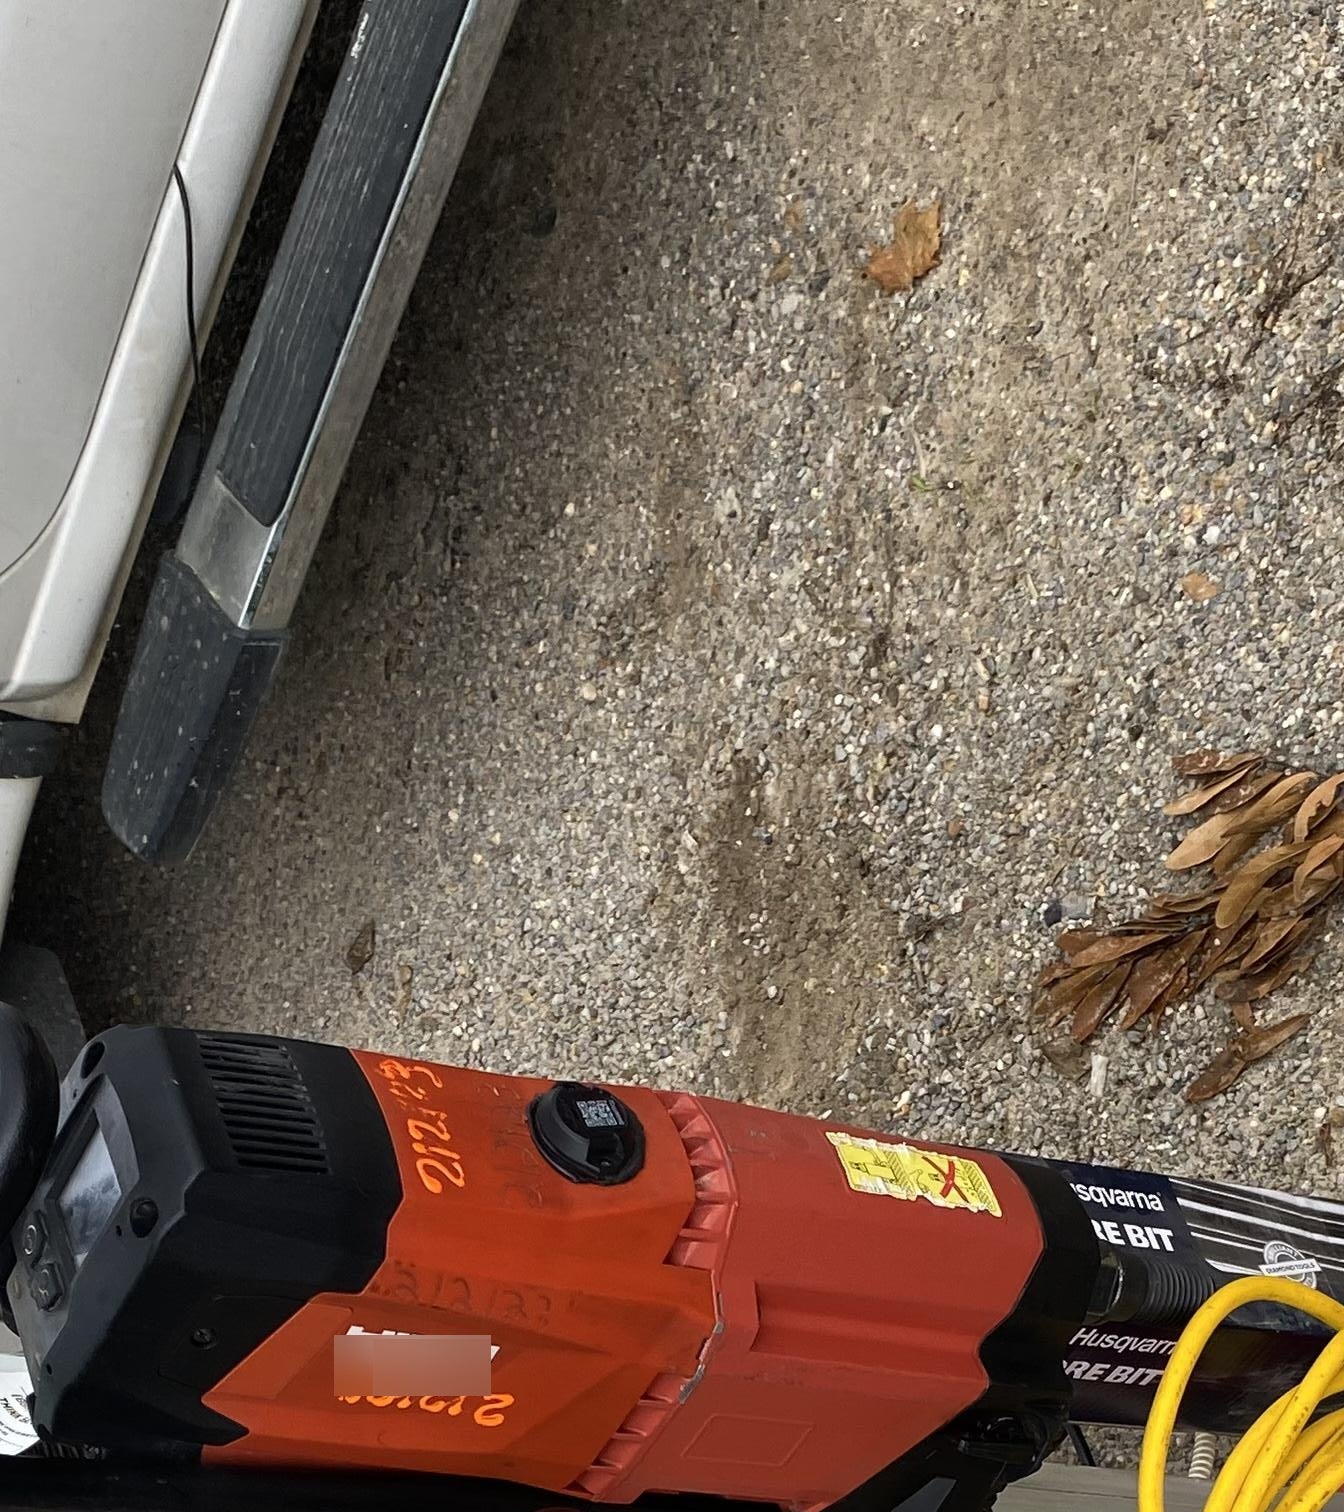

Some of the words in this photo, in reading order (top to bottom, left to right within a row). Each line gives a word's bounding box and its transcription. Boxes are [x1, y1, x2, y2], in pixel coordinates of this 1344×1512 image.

[1070, 1182, 1164, 1212] sqvarna
[1127, 1222, 1174, 1252] BIT
[1069, 1328, 1178, 1356] Husqvarn
[1062, 1359, 1107, 1381] RE
[1104, 1365, 1165, 1386] BIT
